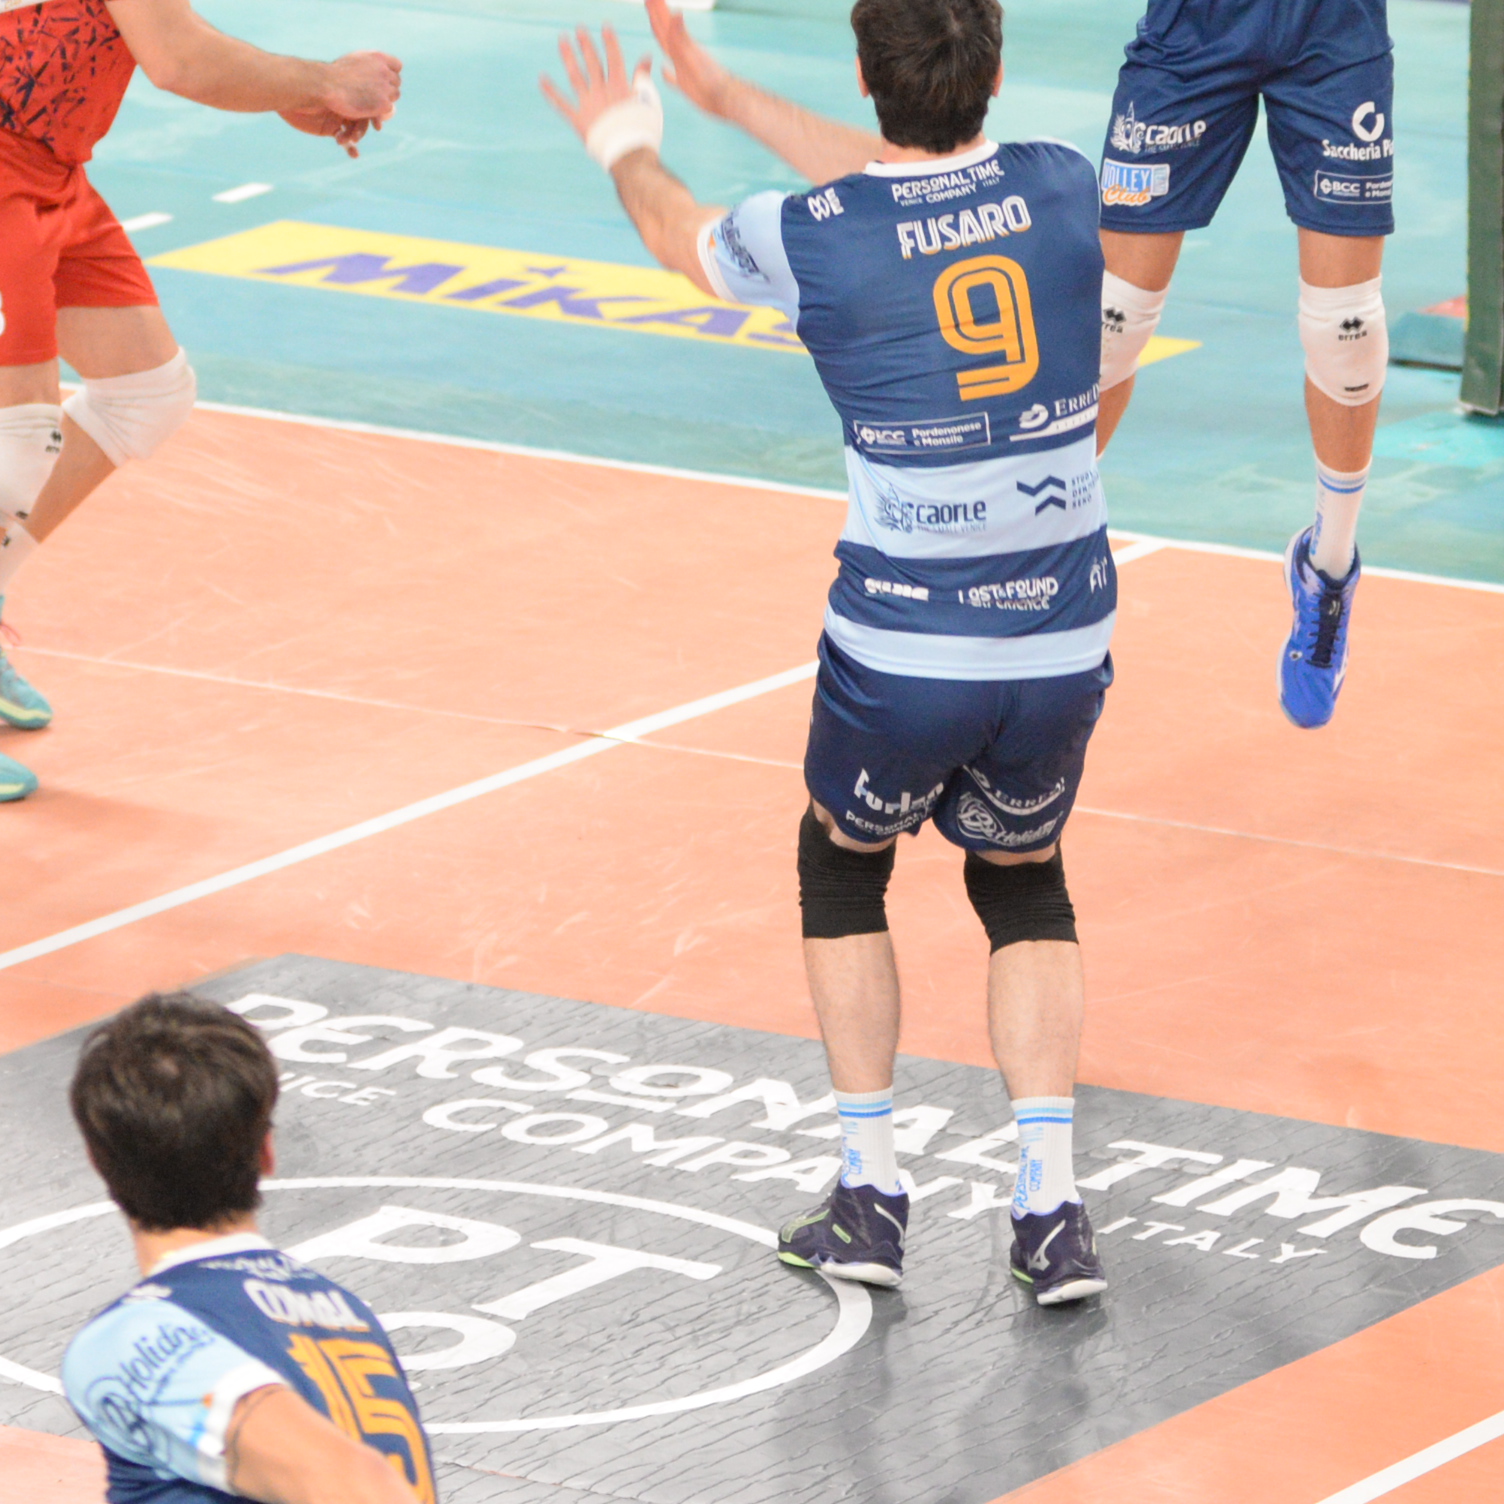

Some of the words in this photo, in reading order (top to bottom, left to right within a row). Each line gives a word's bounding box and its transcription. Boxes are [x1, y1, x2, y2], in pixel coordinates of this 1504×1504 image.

[1322, 138, 1382, 162] Saccheria
[892, 170, 972, 202] PERSONAL
[969, 159, 1005, 183] TIME
[926, 183, 977, 204] COMPANY
[1103, 160, 1150, 194] VOLLEY
[1103, 183, 1151, 204] Club
[897, 195, 1032, 259] FUSARO
[933, 254, 1040, 402] 9
[911, 421, 982, 437] Pordenonese
[1096, 1215, 1330, 1265] ITALY
